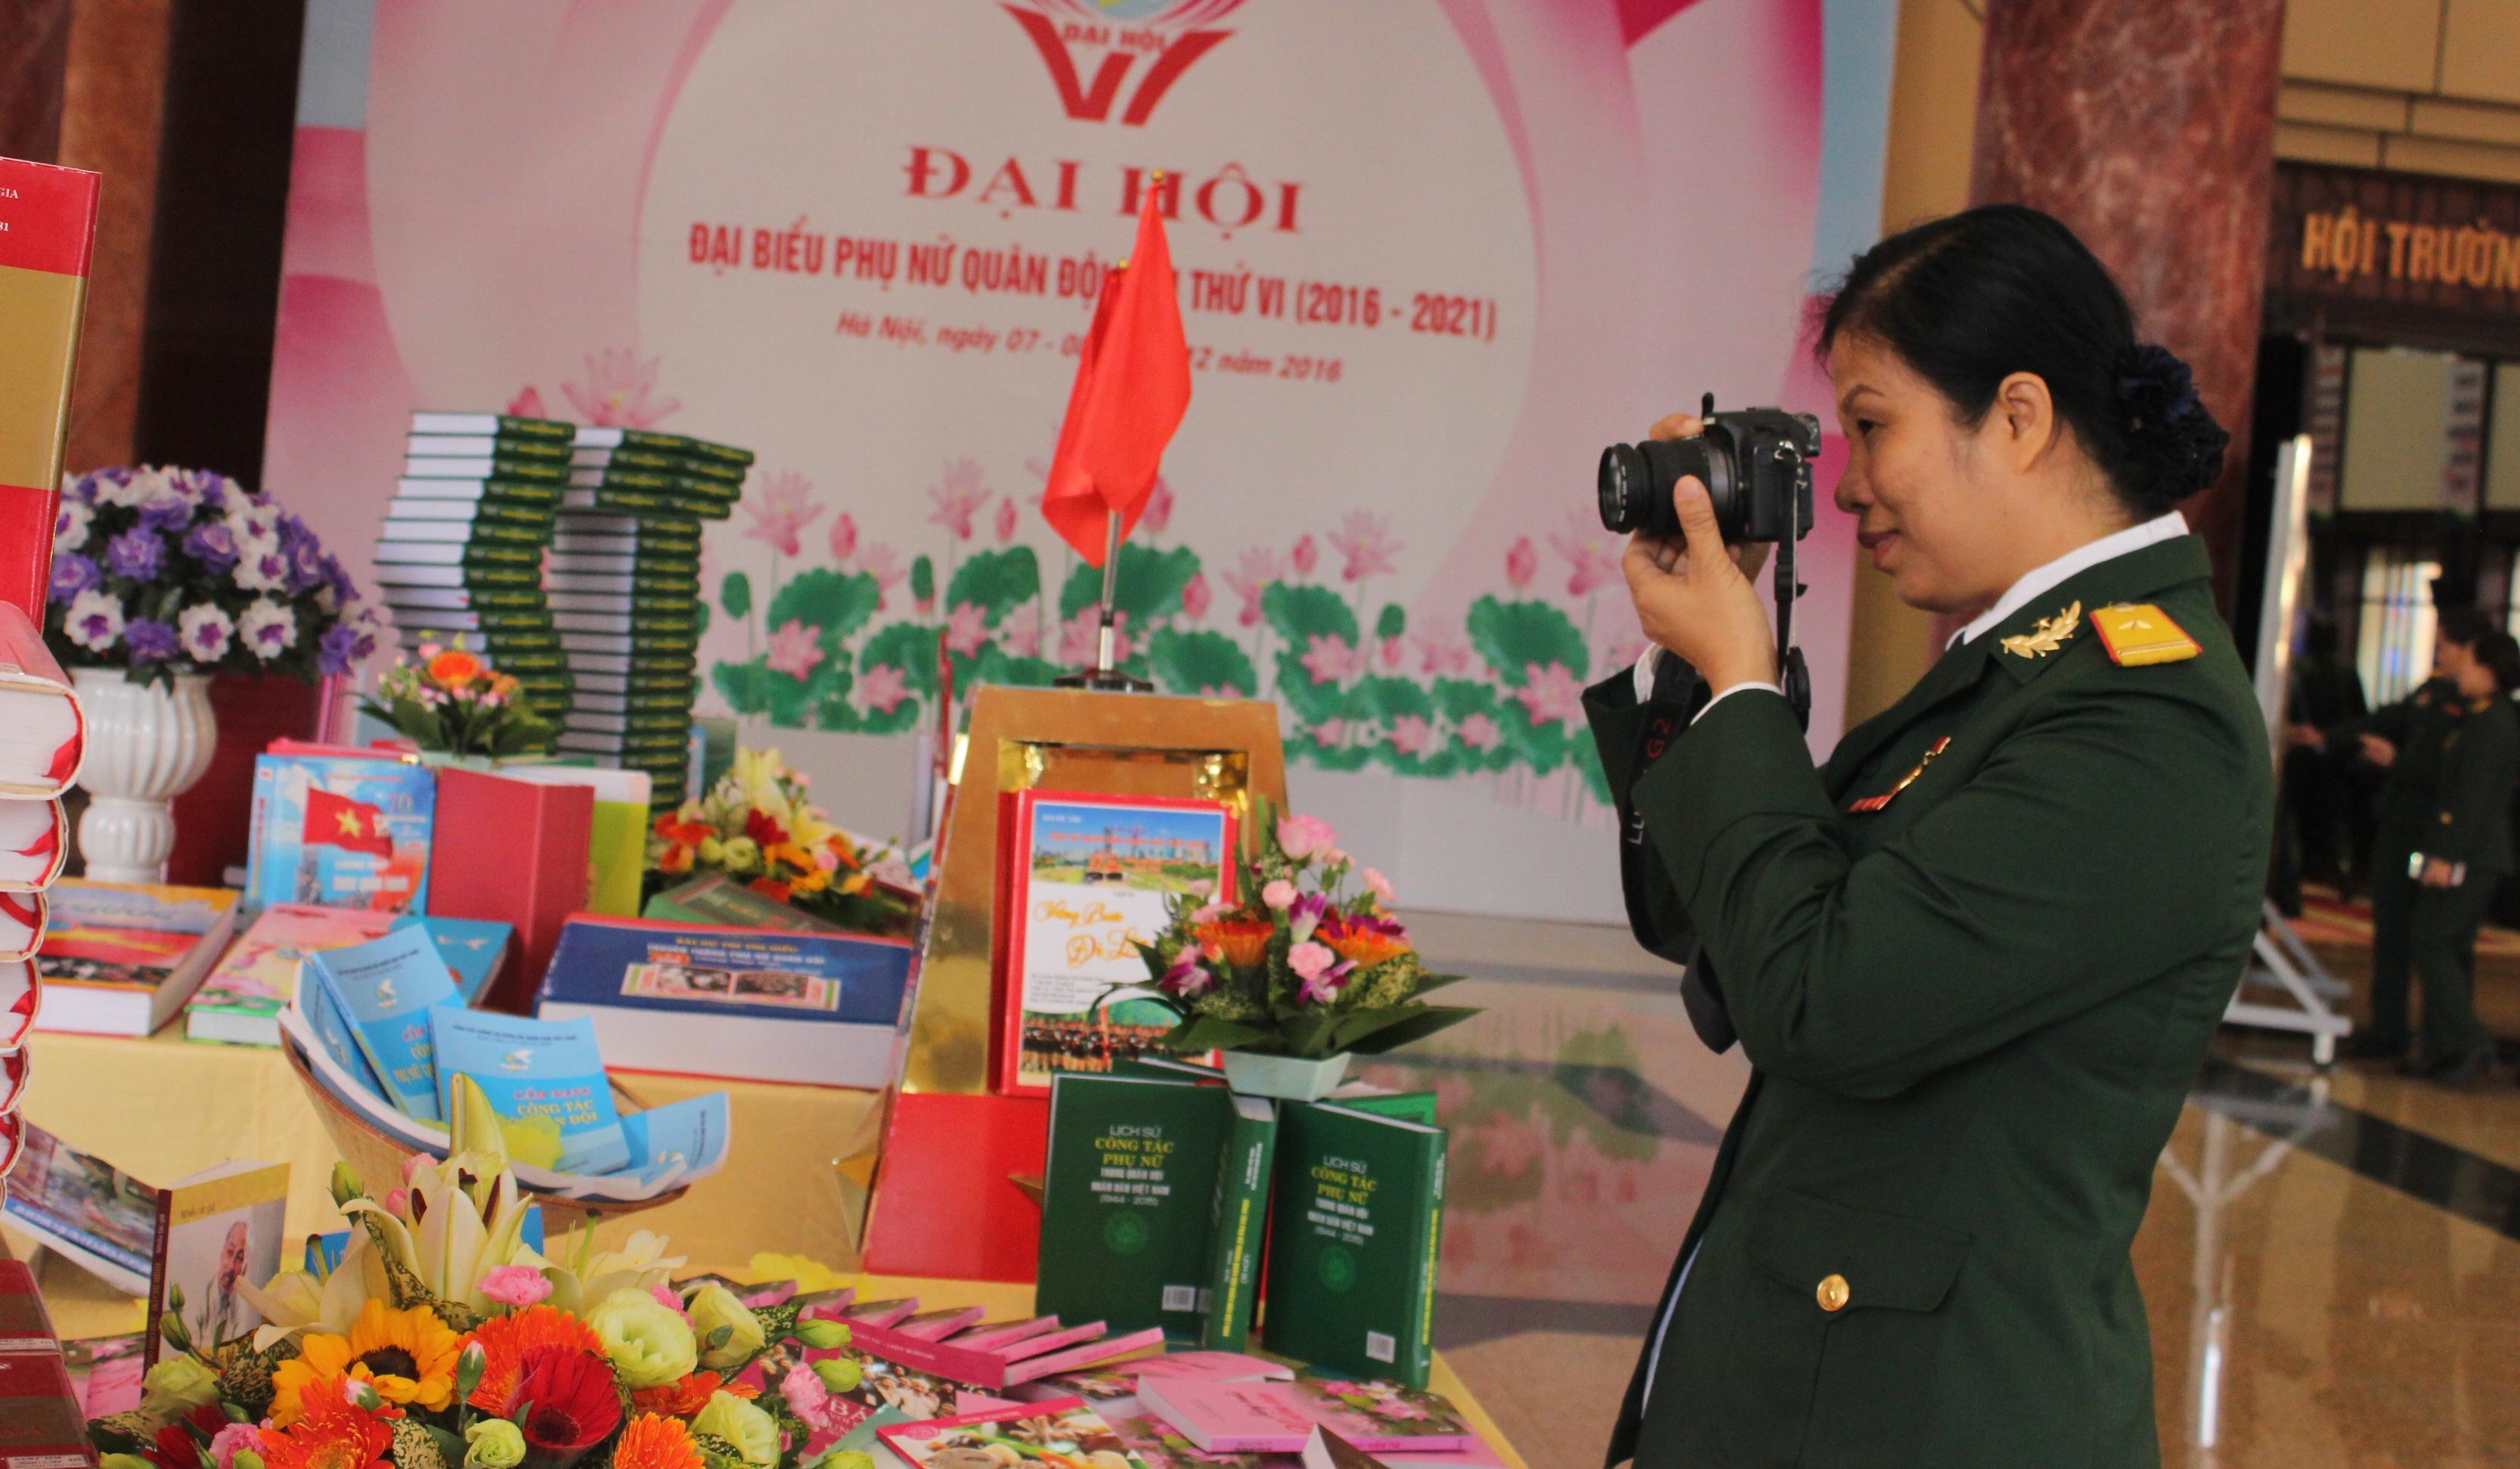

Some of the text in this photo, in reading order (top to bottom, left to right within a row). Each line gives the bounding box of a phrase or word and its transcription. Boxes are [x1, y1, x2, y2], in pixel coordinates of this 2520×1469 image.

[903, 145, 1306, 240] ĐẠI HỘI
[689, 222, 742, 277] ĐẠI
[752, 212, 826, 275] BIỂU
[835, 237, 899, 293] PHỤ
[907, 233, 958, 287] NỮ
[961, 243, 1049, 296] QUÂN
[1190, 259, 1254, 316] THỨ
[1257, 277, 1285, 319] VI
[1296, 280, 1382, 330] (2016
[1410, 291, 1498, 342] 2021)
[2302, 205, 2376, 284] HỘI
[1280, 355, 1344, 383] 2016
[1094, 1136, 1174, 1154] CÔNG TÁC
